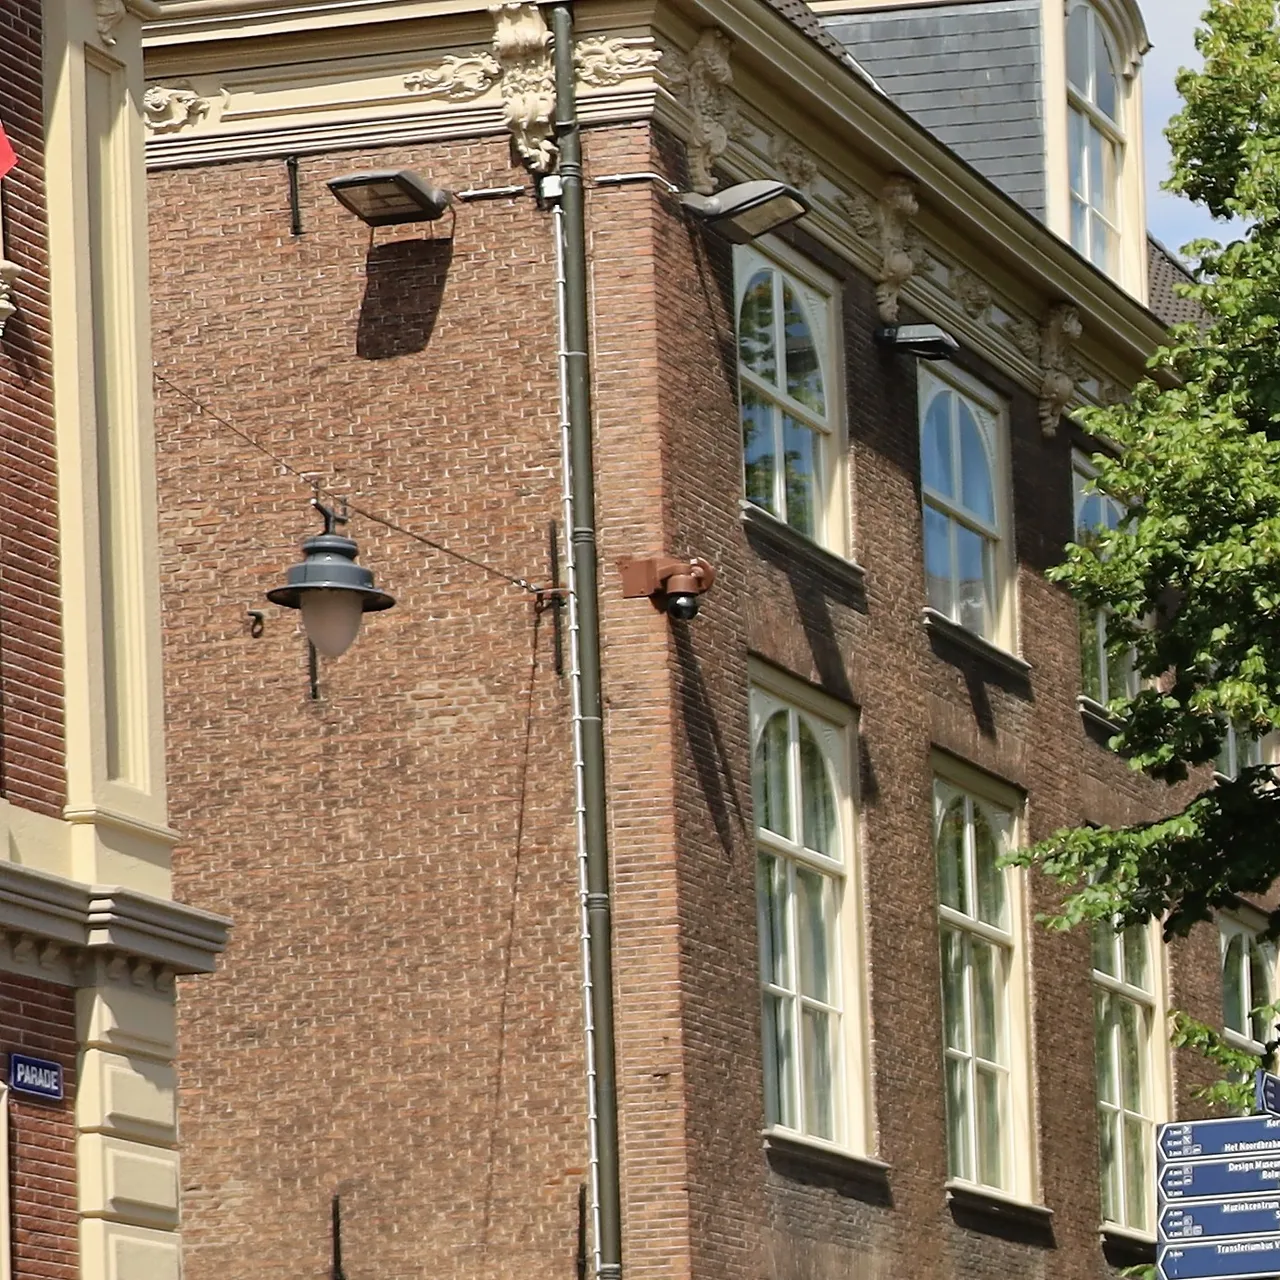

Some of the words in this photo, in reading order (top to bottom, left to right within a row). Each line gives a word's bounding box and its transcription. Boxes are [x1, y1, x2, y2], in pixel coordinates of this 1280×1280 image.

[17, 1063, 59, 1090] PARADE
[1224, 1142, 1239, 1152] Het
[1228, 1162, 1254, 1172] Design
[1223, 1201, 1279, 1213] Muziekcentrum
[1217, 1243, 1274, 1254] Transferiumbus
